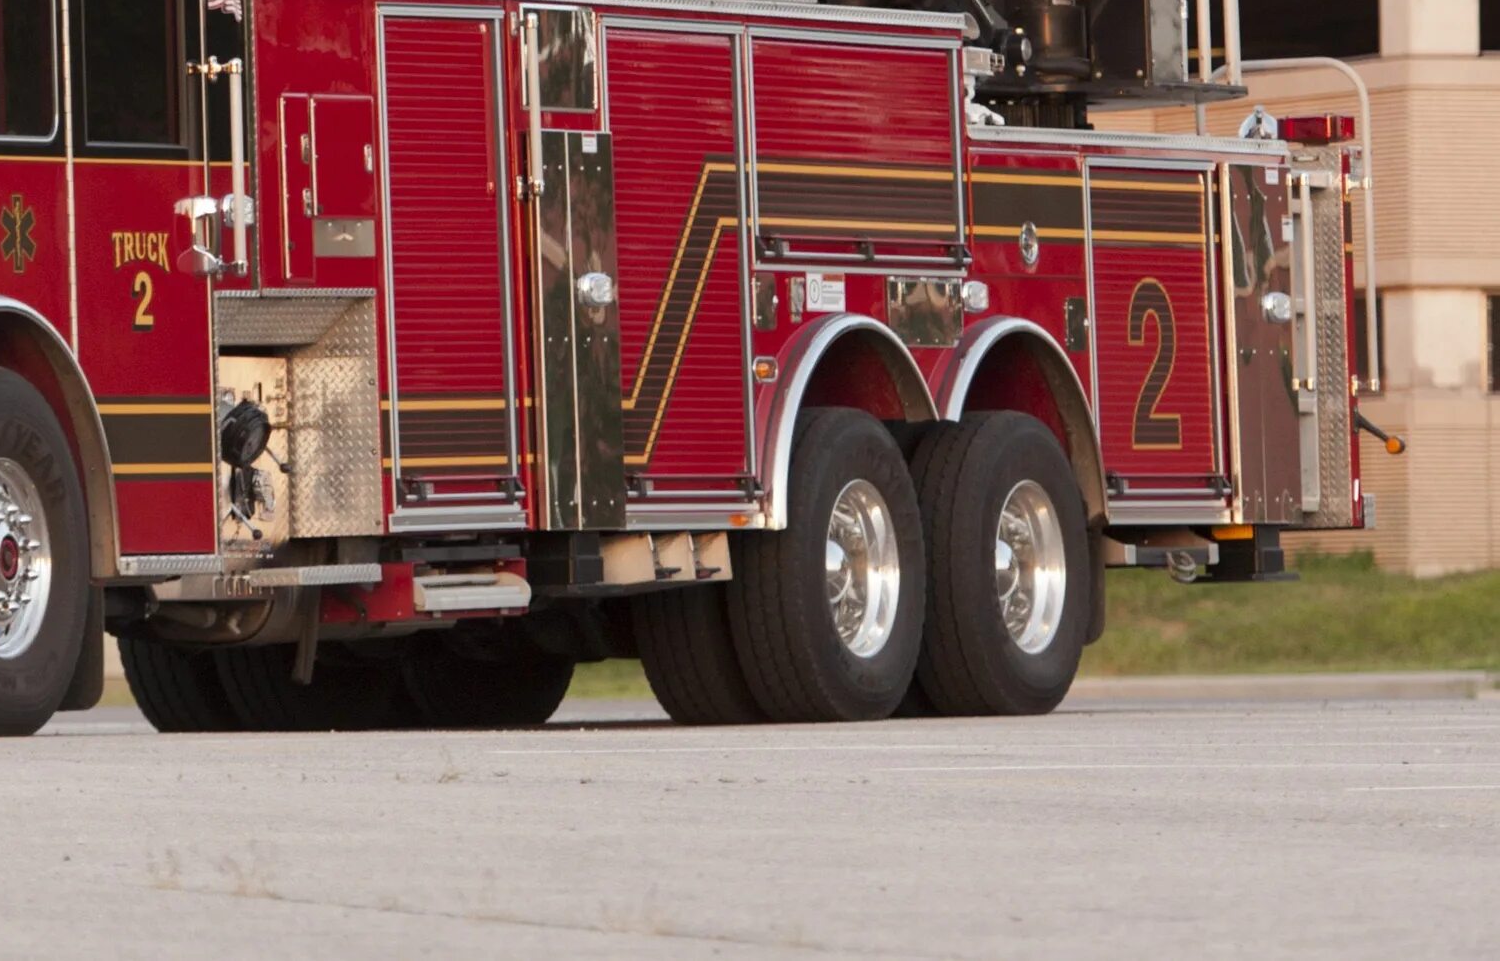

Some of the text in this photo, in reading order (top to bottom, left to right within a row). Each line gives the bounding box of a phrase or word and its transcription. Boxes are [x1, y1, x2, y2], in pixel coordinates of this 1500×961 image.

[111, 231, 170, 274] TRUCK
[132, 271, 154, 332] 2
[1127, 277, 1182, 450] 2
